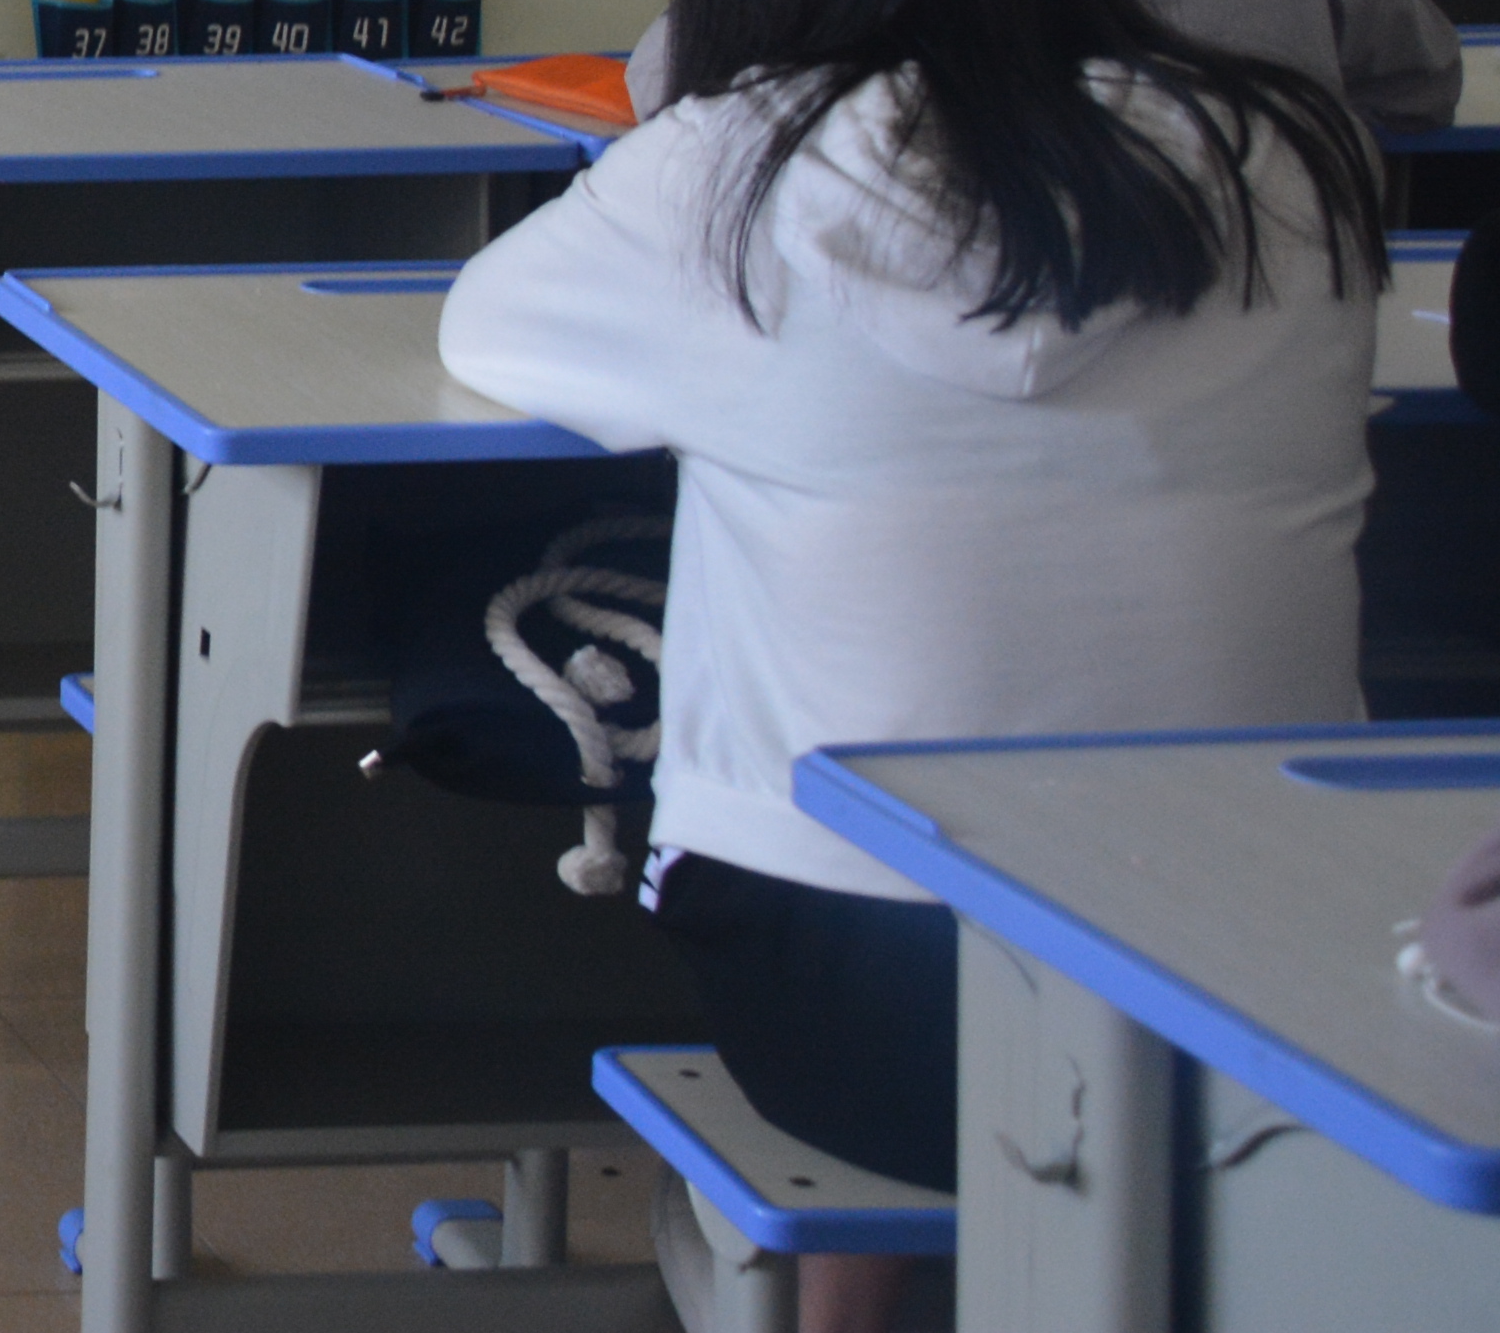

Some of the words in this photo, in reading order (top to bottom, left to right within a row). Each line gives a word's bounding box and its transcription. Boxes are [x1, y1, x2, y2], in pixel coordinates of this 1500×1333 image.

[74, 28, 107, 58] 37
[136, 24, 169, 55] 38
[204, 24, 241, 55] 39
[273, 22, 308, 55] 40
[353, 18, 388, 47] 41
[432, 16, 467, 44] 42
